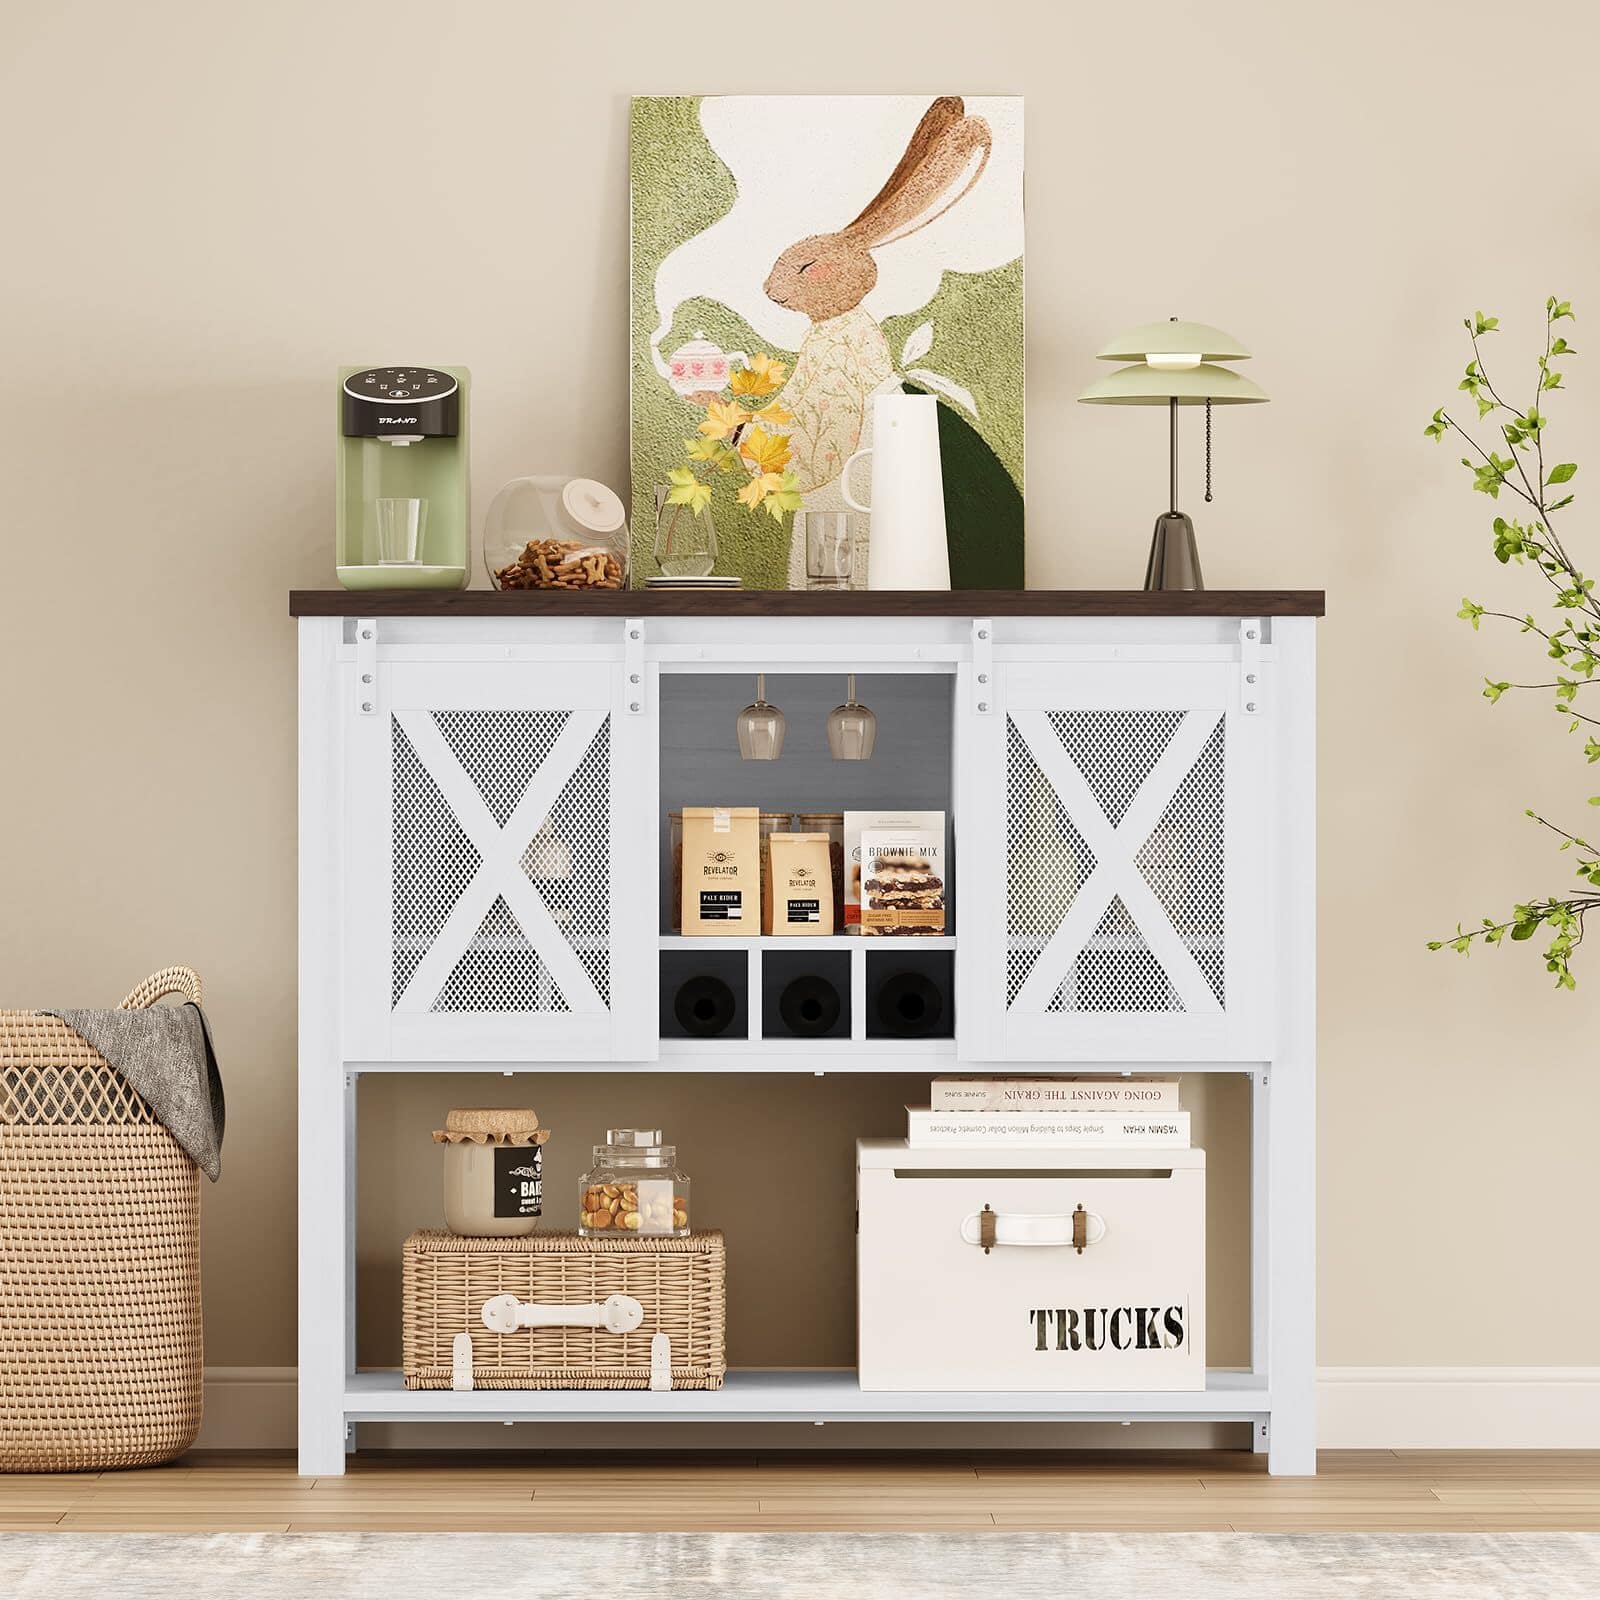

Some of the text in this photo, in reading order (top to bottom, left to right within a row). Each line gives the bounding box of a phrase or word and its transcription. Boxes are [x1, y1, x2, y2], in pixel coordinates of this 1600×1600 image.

[869, 847, 938, 857] BROWNIE MIX
[703, 866, 738, 876] REVELATOR
[789, 879, 816, 888] REVELATOR
[1004, 1090, 1162, 1100] GOING AGAINST THE GRAIN
[930, 1125, 956, 1134] Practices
[958, 1125, 987, 1134] Cosmetic
[987, 1125, 1006, 1134] Dollar
[1007, 1125, 1029, 1134] Million
[1030, 1124, 1056, 1134] Building
[1065, 1125, 1082, 1134] Steps
[1083, 1125, 1105, 1134] Simple
[1123, 1125, 1178, 1134] YASMIN KHAN
[1030, 1305, 1184, 1351] TRUCKS
